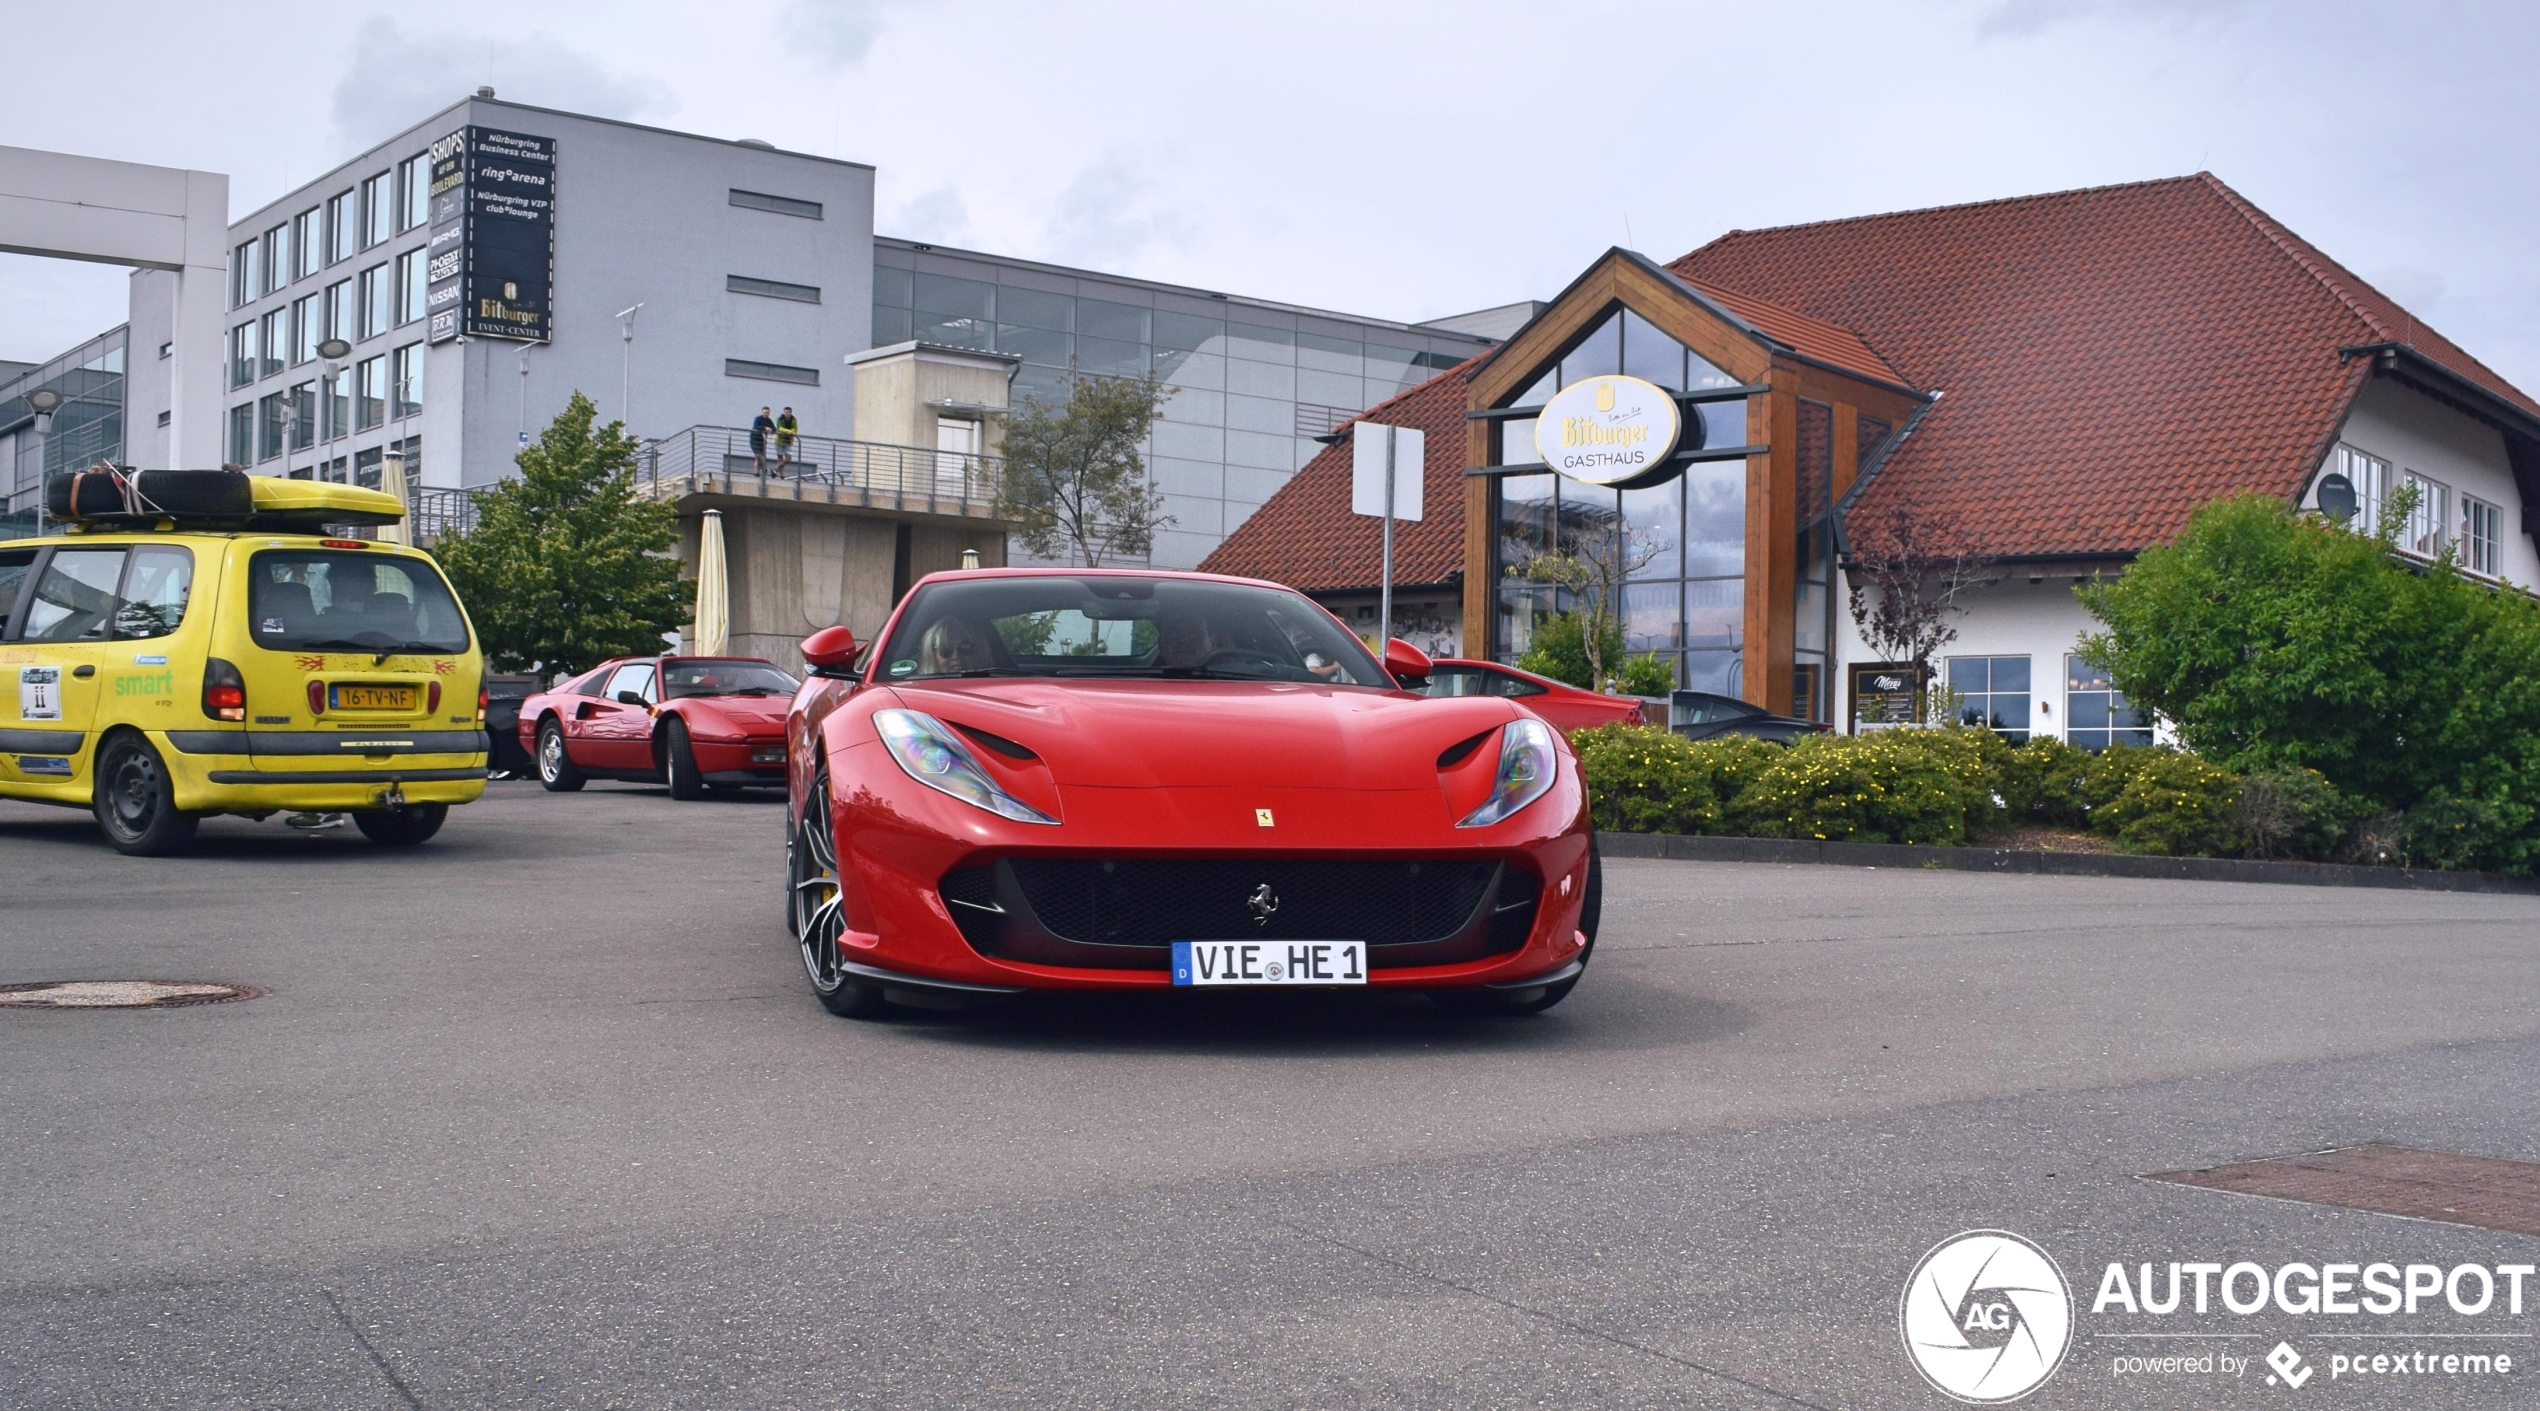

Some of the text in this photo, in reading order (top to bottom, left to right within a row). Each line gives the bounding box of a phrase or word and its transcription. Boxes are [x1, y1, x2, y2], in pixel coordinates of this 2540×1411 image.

[432, 130, 463, 165] SHOPS
[489, 134, 541, 151] Nürburgring
[479, 143, 550, 161] Business Center
[477, 191, 548, 208] Nürburgring VIP
[429, 284, 460, 306] NISSAN
[481, 298, 539, 325] Bitburger
[478, 322, 540, 337] EVENT-CENTER
[1562, 417, 1648, 448] Bitburger
[1564, 450, 1644, 468] GASTHAUS
[115, 669, 173, 696] smart
[1874, 675, 1901, 690] Menu
[345, 689, 408, 705] 16-TV-NF
[1196, 945, 1362, 979] VIE HE 1
[1179, 968, 1187, 978] D
